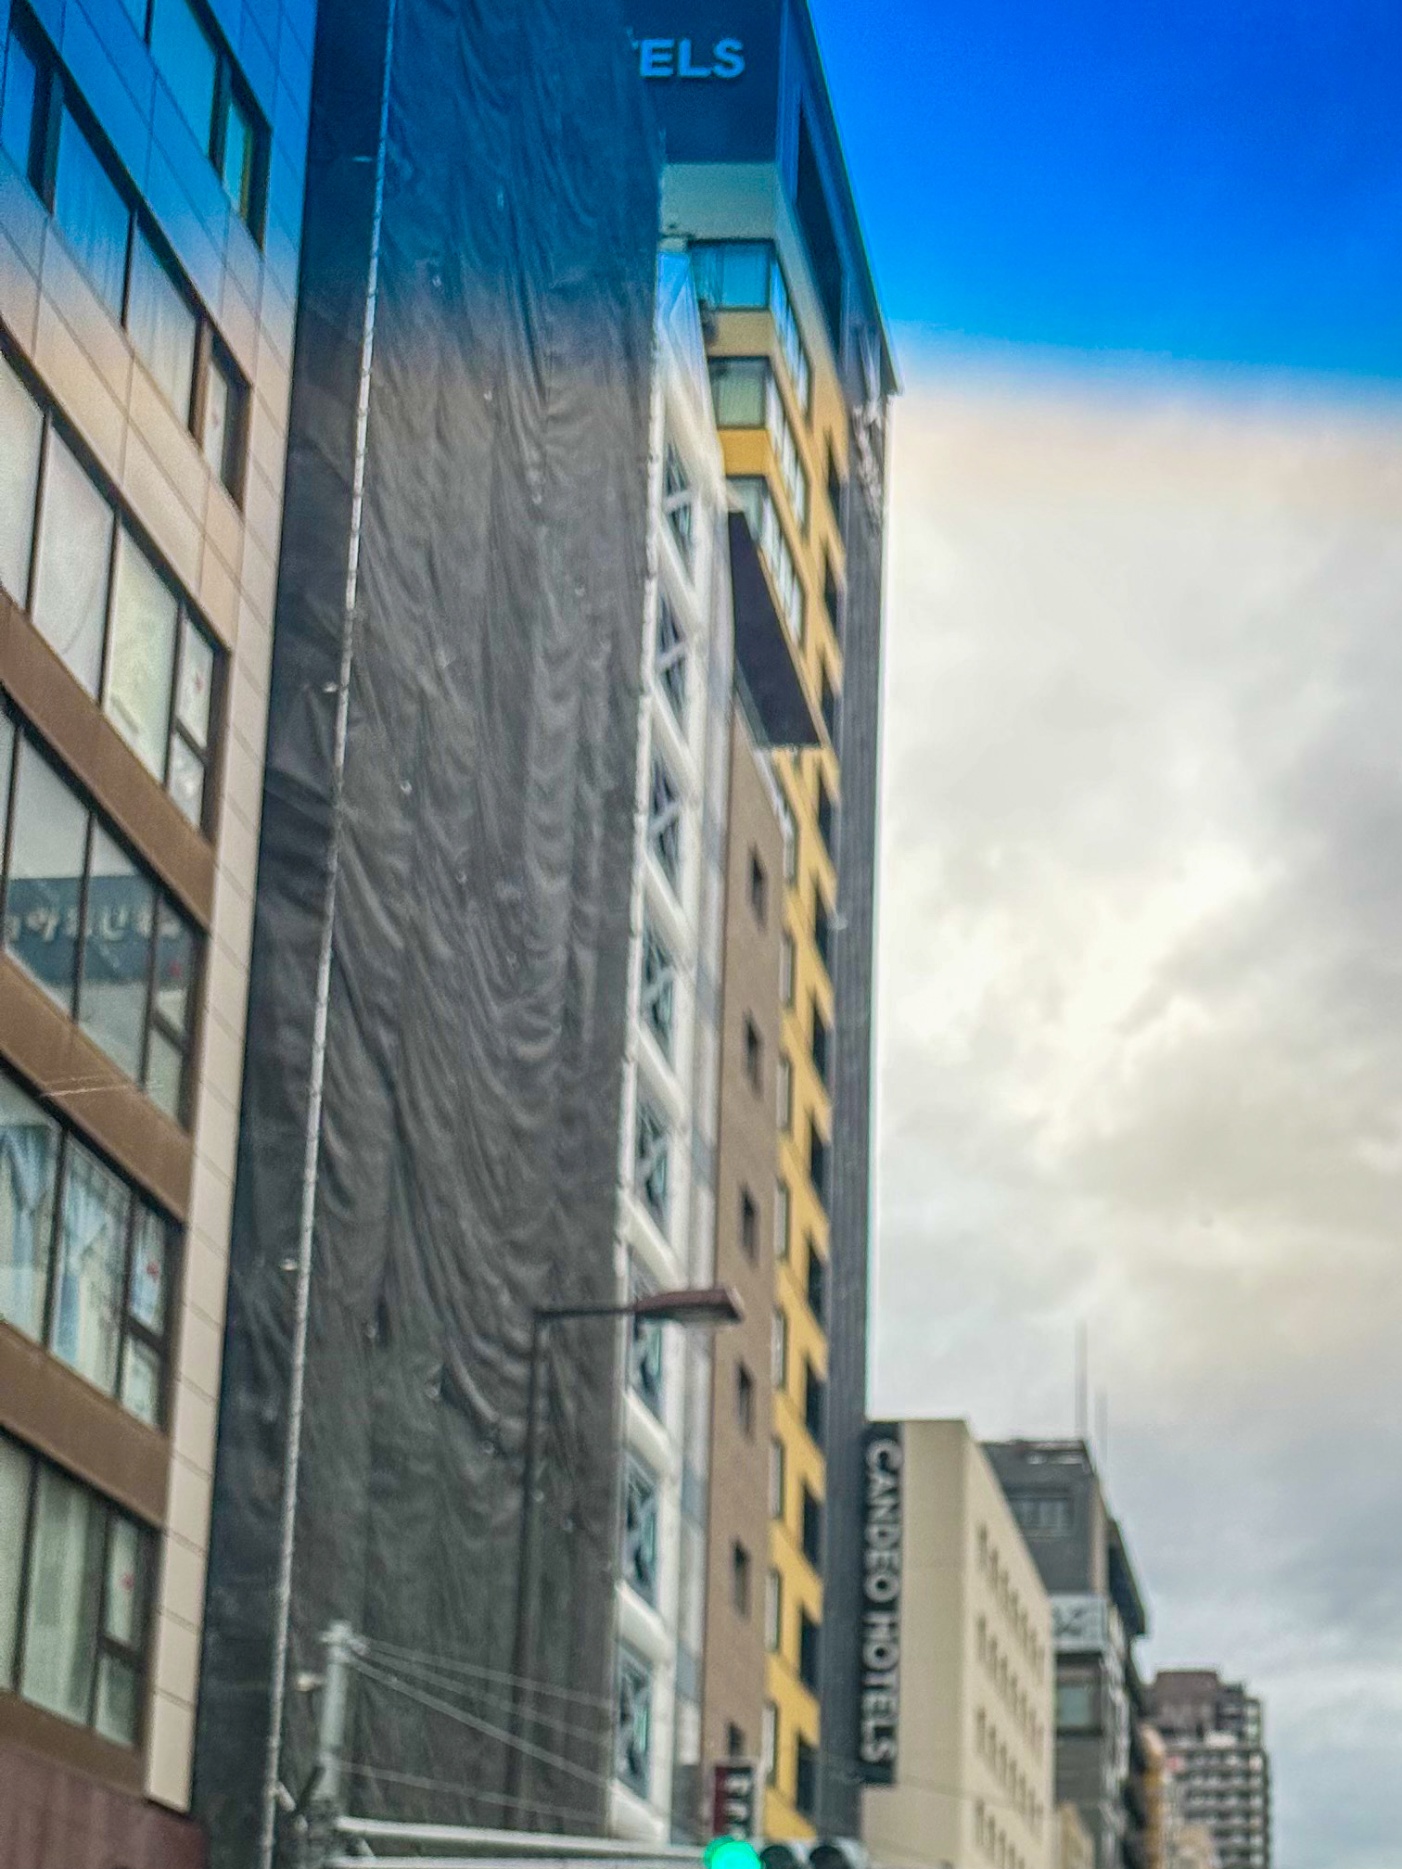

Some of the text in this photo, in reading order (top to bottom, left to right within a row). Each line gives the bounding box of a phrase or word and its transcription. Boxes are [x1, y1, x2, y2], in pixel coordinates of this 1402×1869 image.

[630, 33, 746, 79] ELS
[861, 1438, 902, 1764] CANDEO HOTELS
